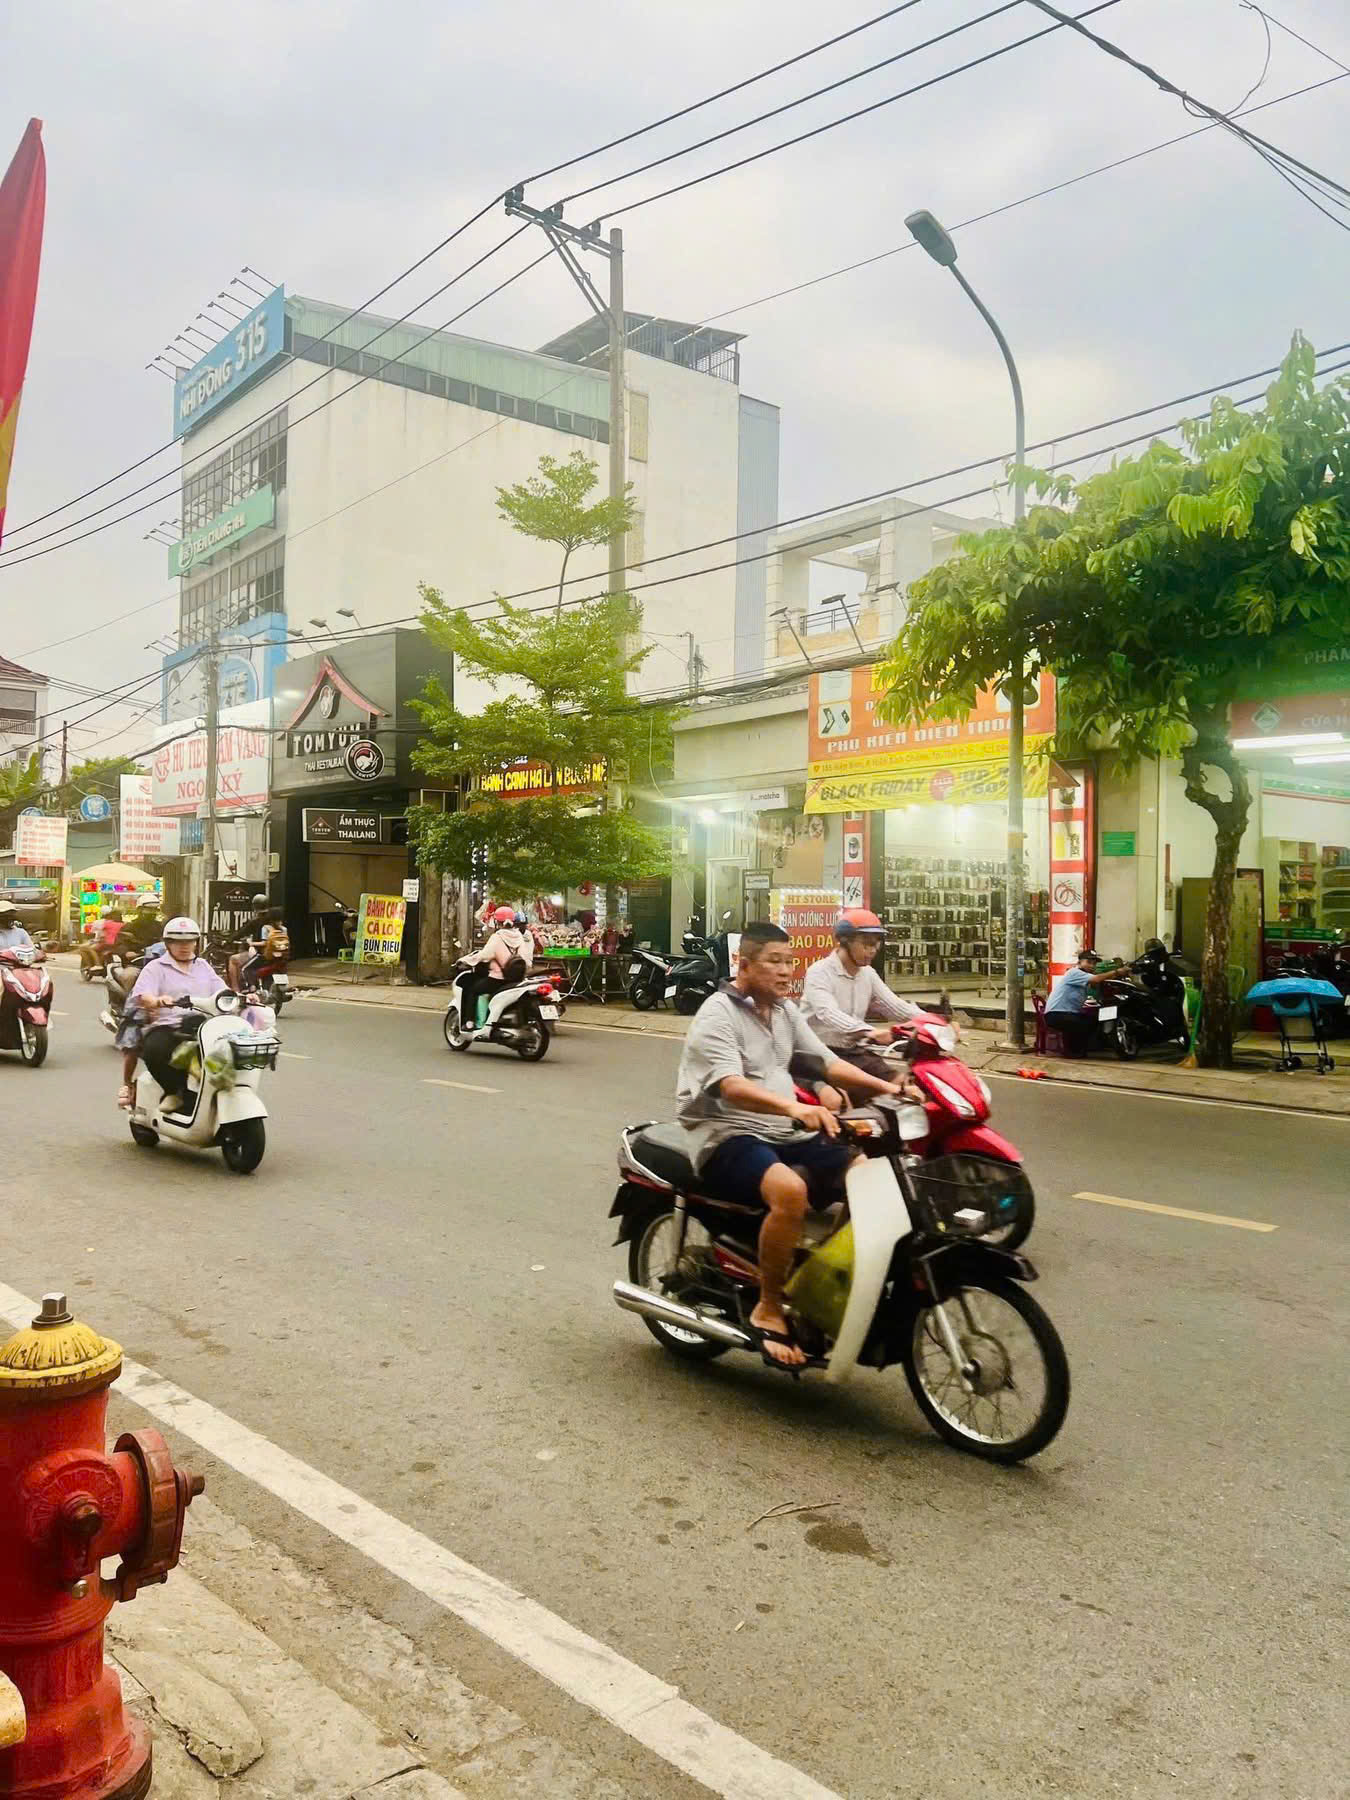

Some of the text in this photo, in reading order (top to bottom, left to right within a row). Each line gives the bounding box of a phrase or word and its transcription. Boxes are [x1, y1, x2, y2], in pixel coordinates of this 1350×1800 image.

[234, 309, 268, 371] 315
[293, 722, 361, 757] TOMYUM
[820, 779, 867, 800] BLACK
[869, 776, 926, 797] FRIDAY
[338, 830, 377, 840] THAILAND
[787, 894, 837, 904] HT STORE
[788, 935, 834, 949] BAO DA
